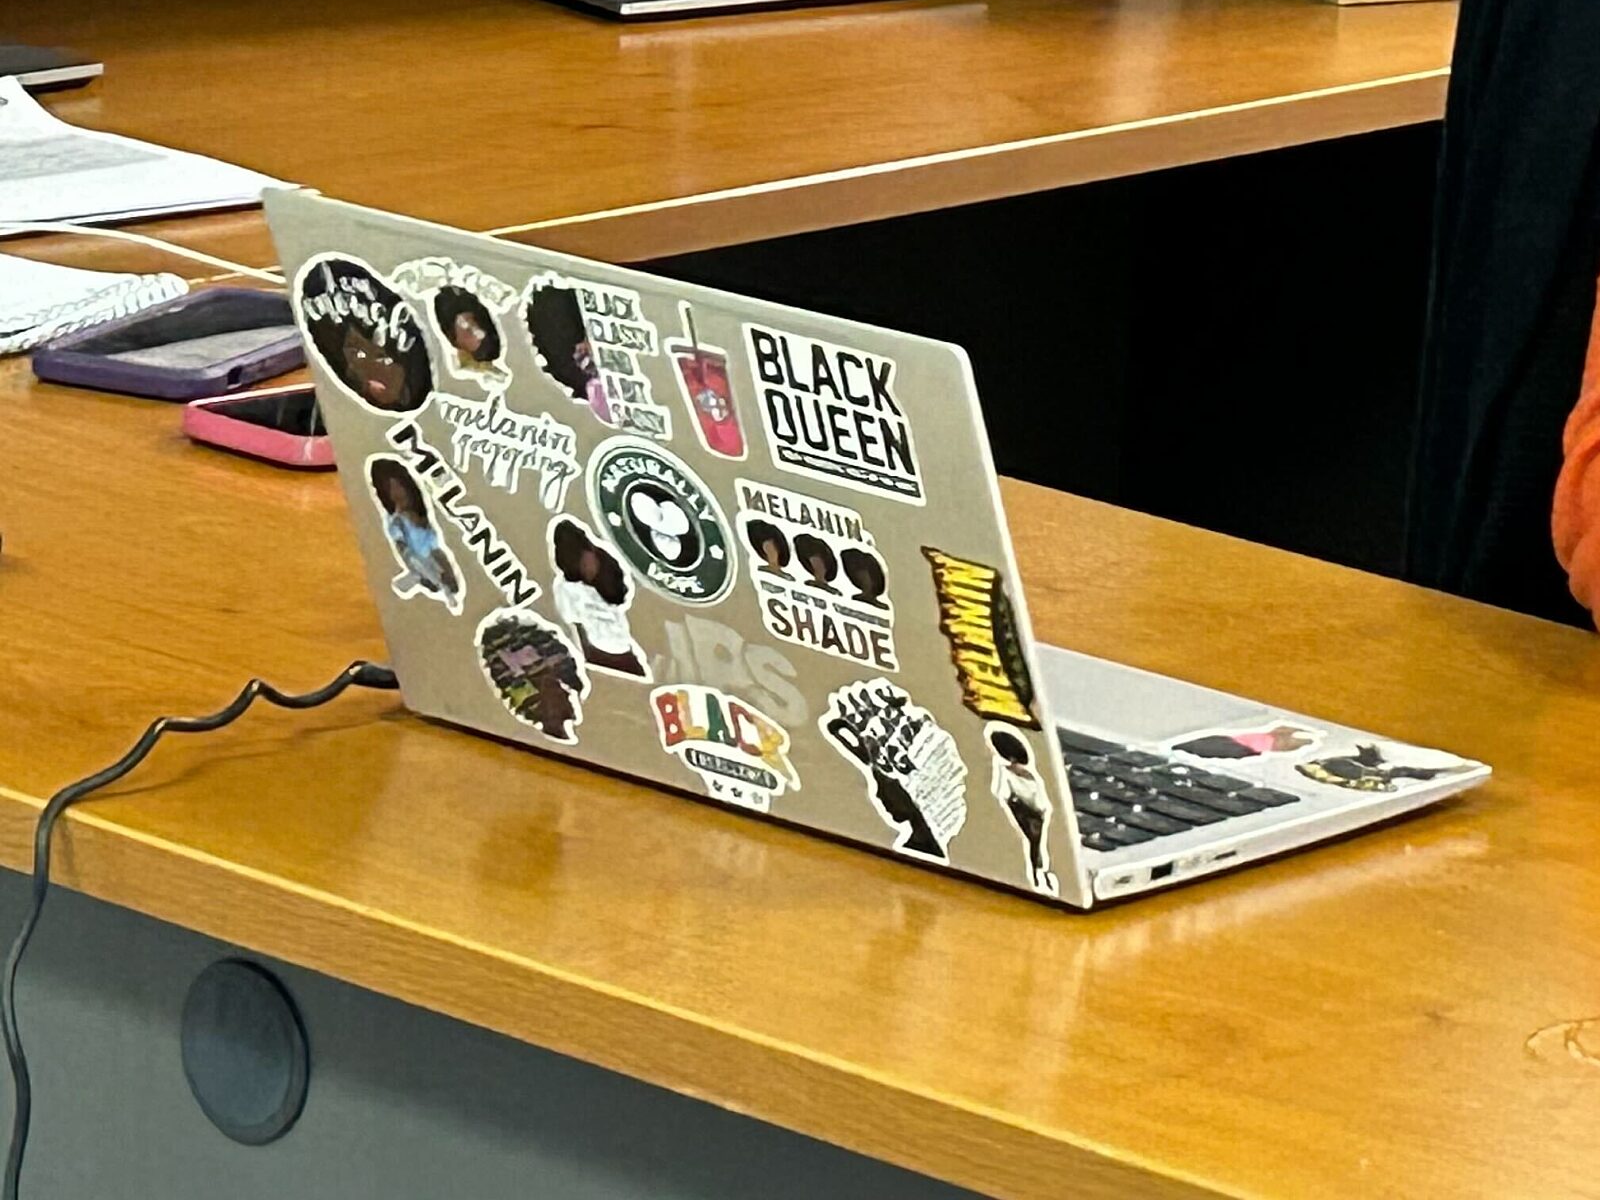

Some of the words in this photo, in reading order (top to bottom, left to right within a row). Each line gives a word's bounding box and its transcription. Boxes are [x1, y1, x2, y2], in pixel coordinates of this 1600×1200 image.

[751, 327, 902, 417] BLACK
[441, 395, 572, 455] melanin
[765, 388, 916, 476] QUEEN
[767, 599, 896, 671] SHADE
[655, 688, 792, 783] BLACK
